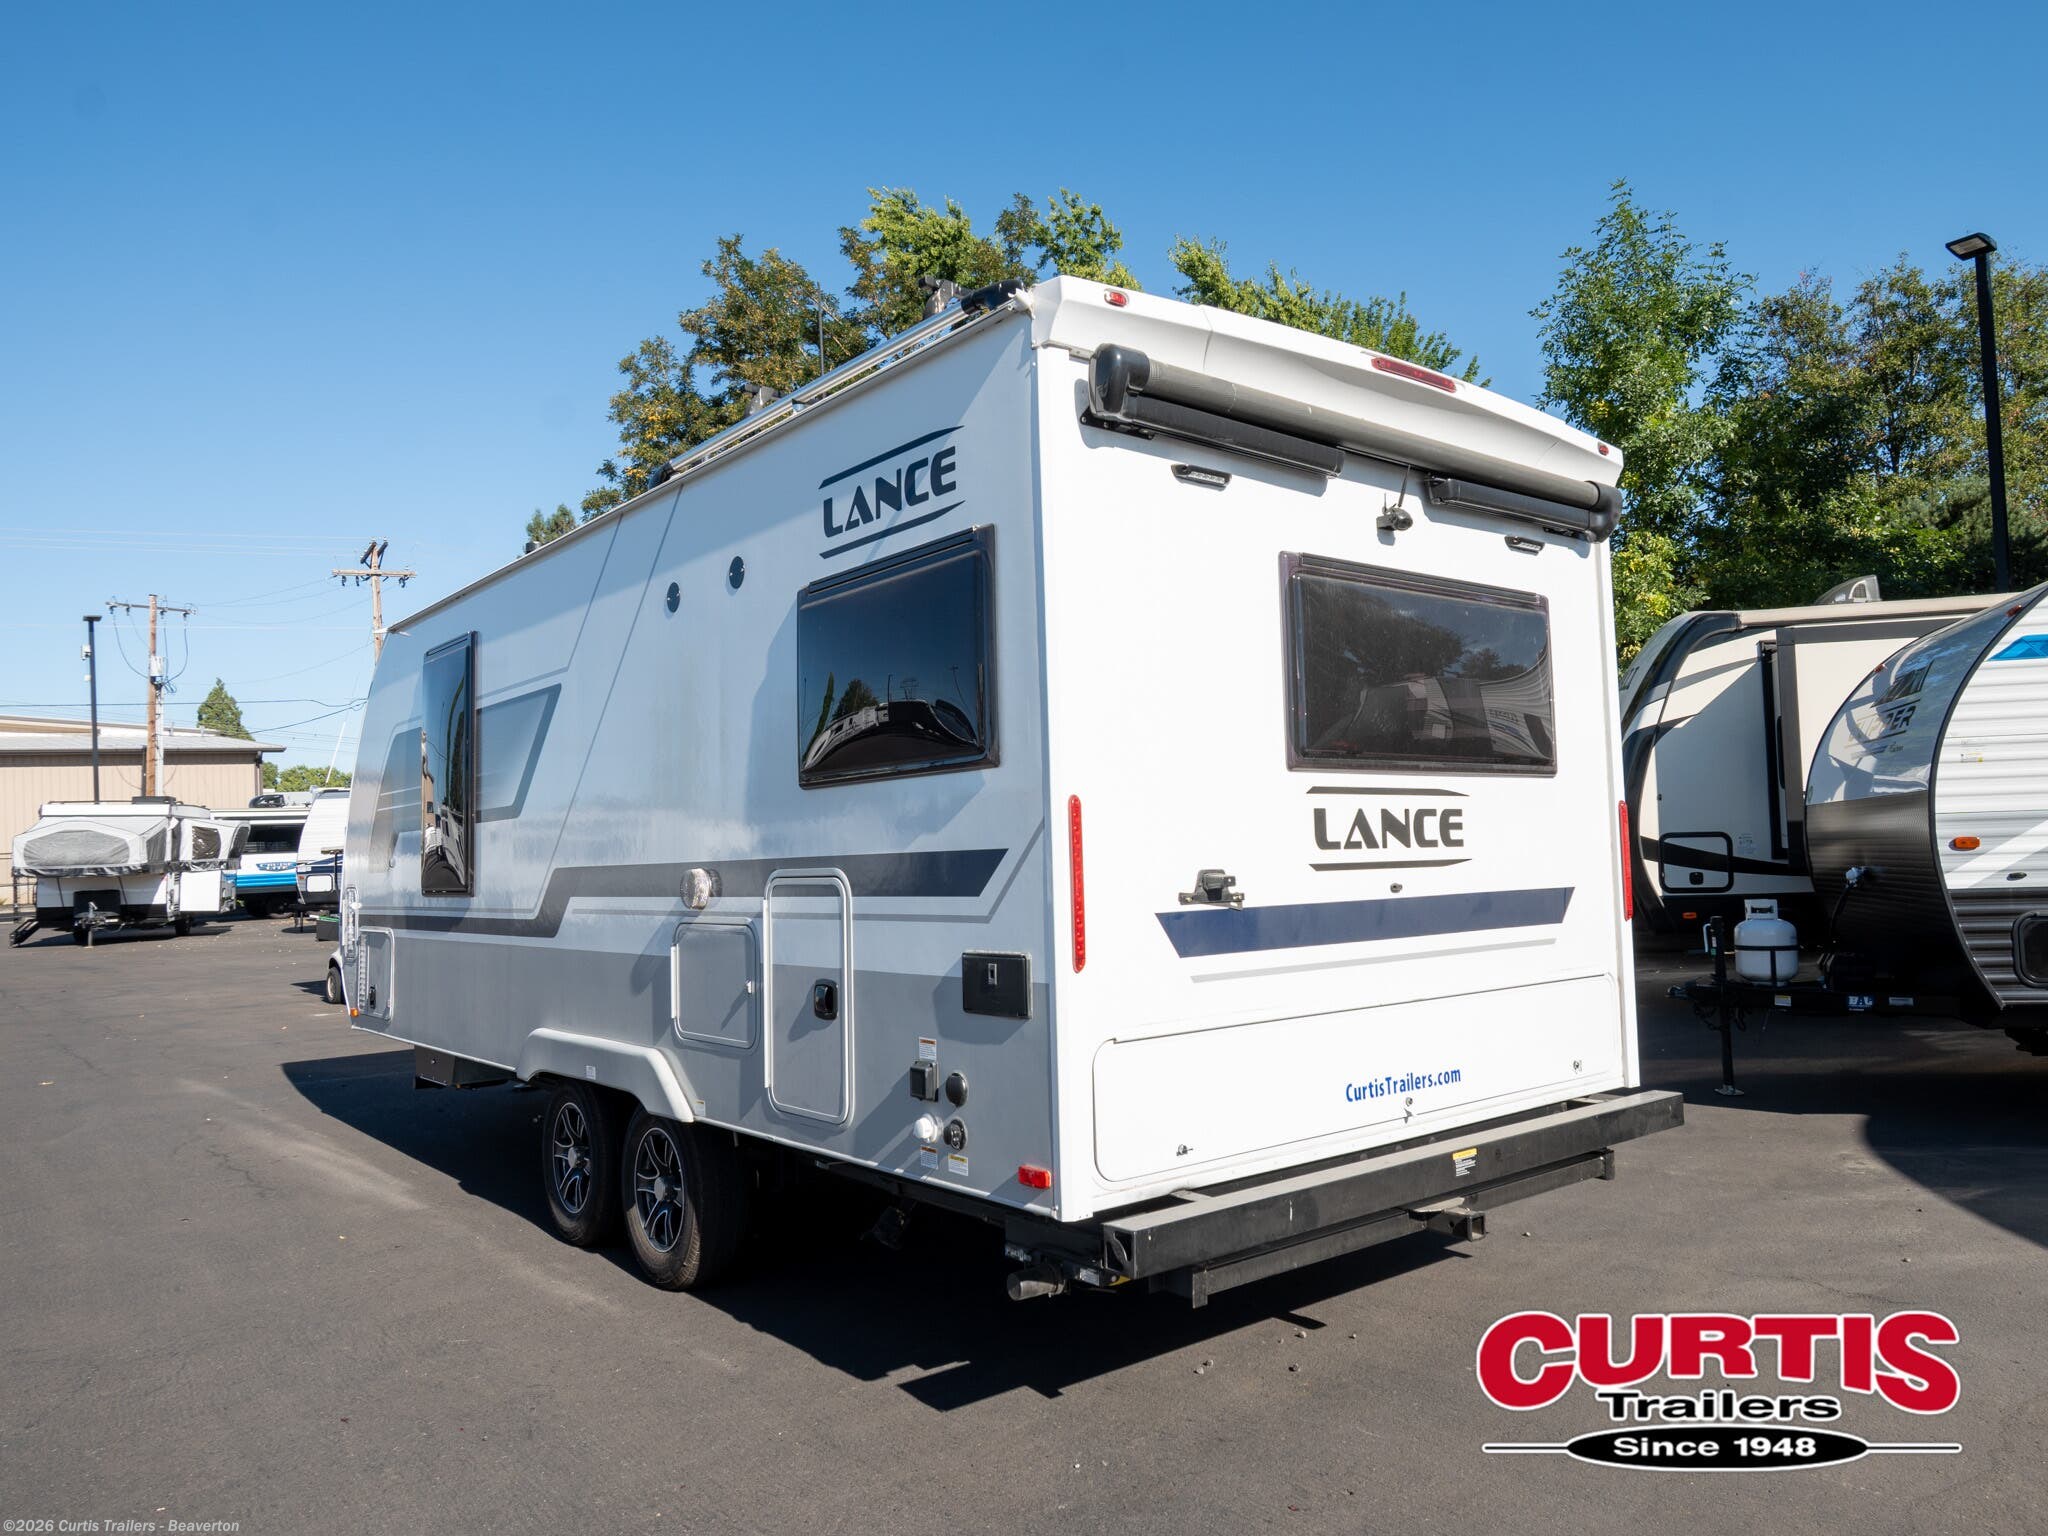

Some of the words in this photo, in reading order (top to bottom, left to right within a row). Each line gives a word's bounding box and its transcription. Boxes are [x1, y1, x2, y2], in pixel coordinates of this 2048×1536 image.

[823, 445, 957, 538] LANCE
[1313, 807, 1465, 851] LANCE
[1345, 1068, 1462, 1103] CurtisTrailers.com
